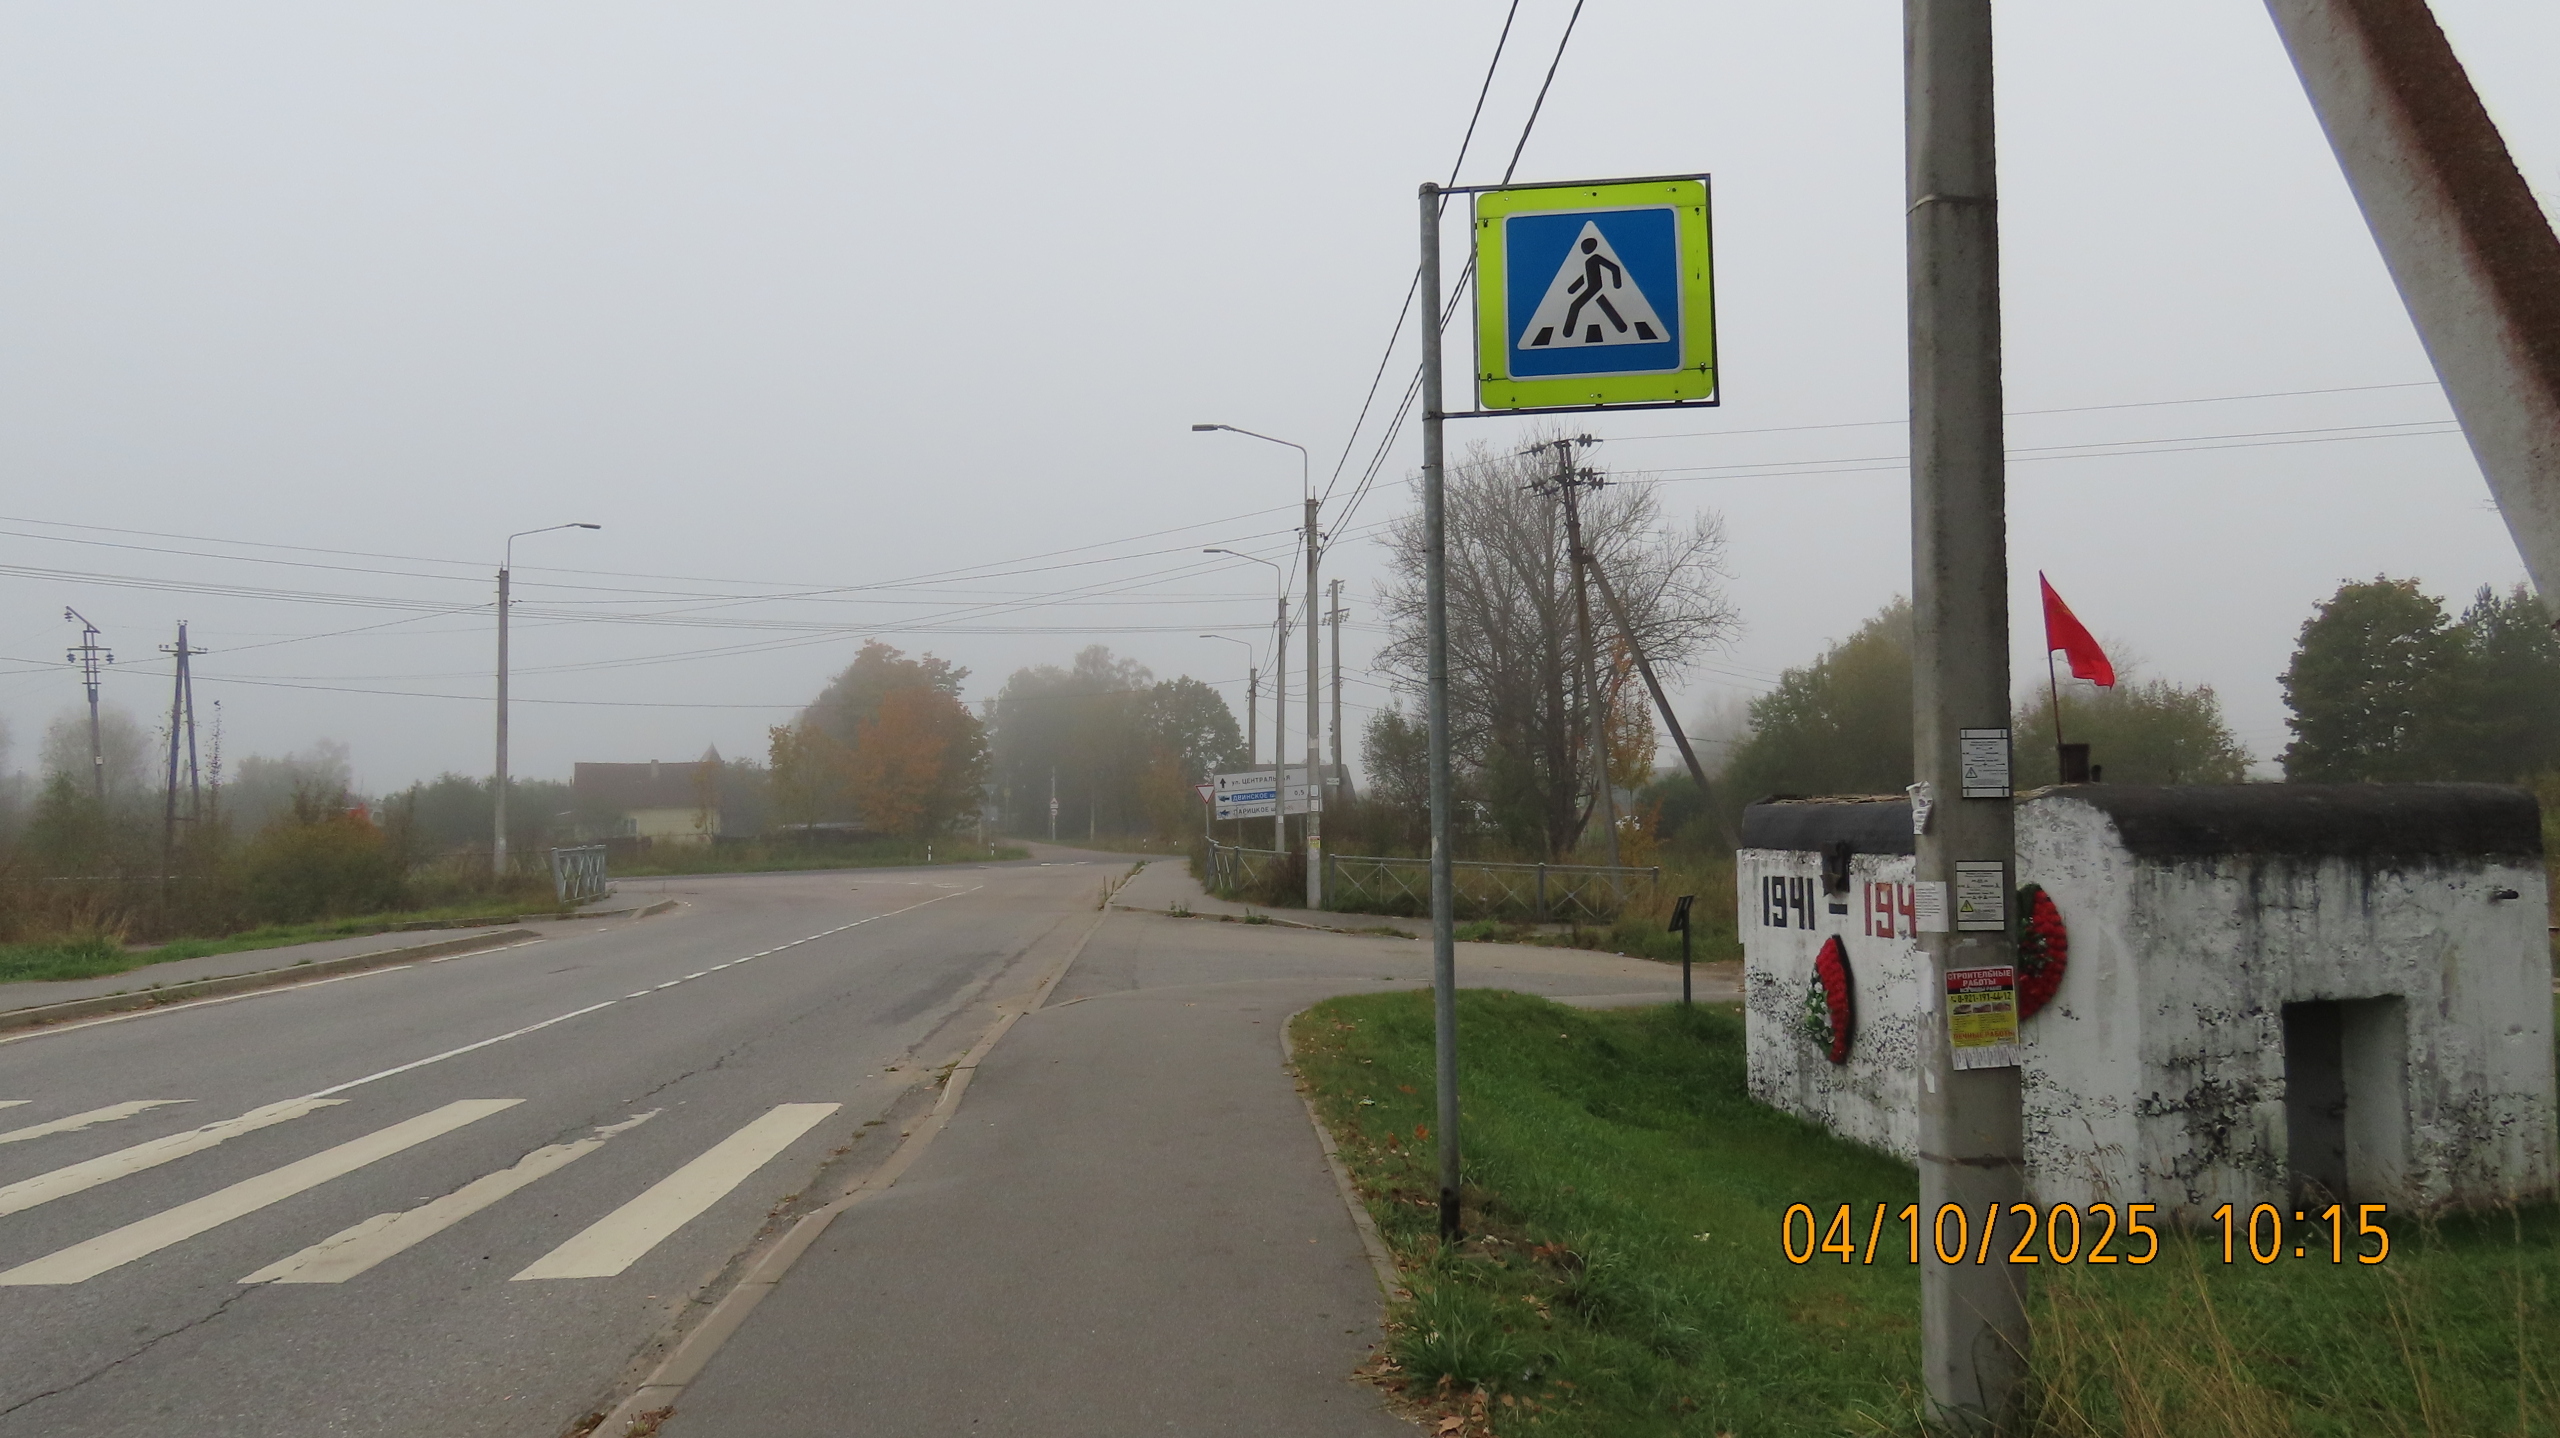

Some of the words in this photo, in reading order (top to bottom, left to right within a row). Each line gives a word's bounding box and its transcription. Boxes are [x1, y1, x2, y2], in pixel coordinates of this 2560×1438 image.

[1242, 775, 1291, 784] ЦЕНТРАЛЬЯ
[1233, 793, 1268, 801] ДВИНСКОЕ
[1763, 875, 1815, 930] 1941
[1864, 881, 1917, 939] 194
[1948, 970, 2011, 980] СТРОИТЕЛЬНЫЕ
[1963, 978, 1996, 986] РАБОТЫ
